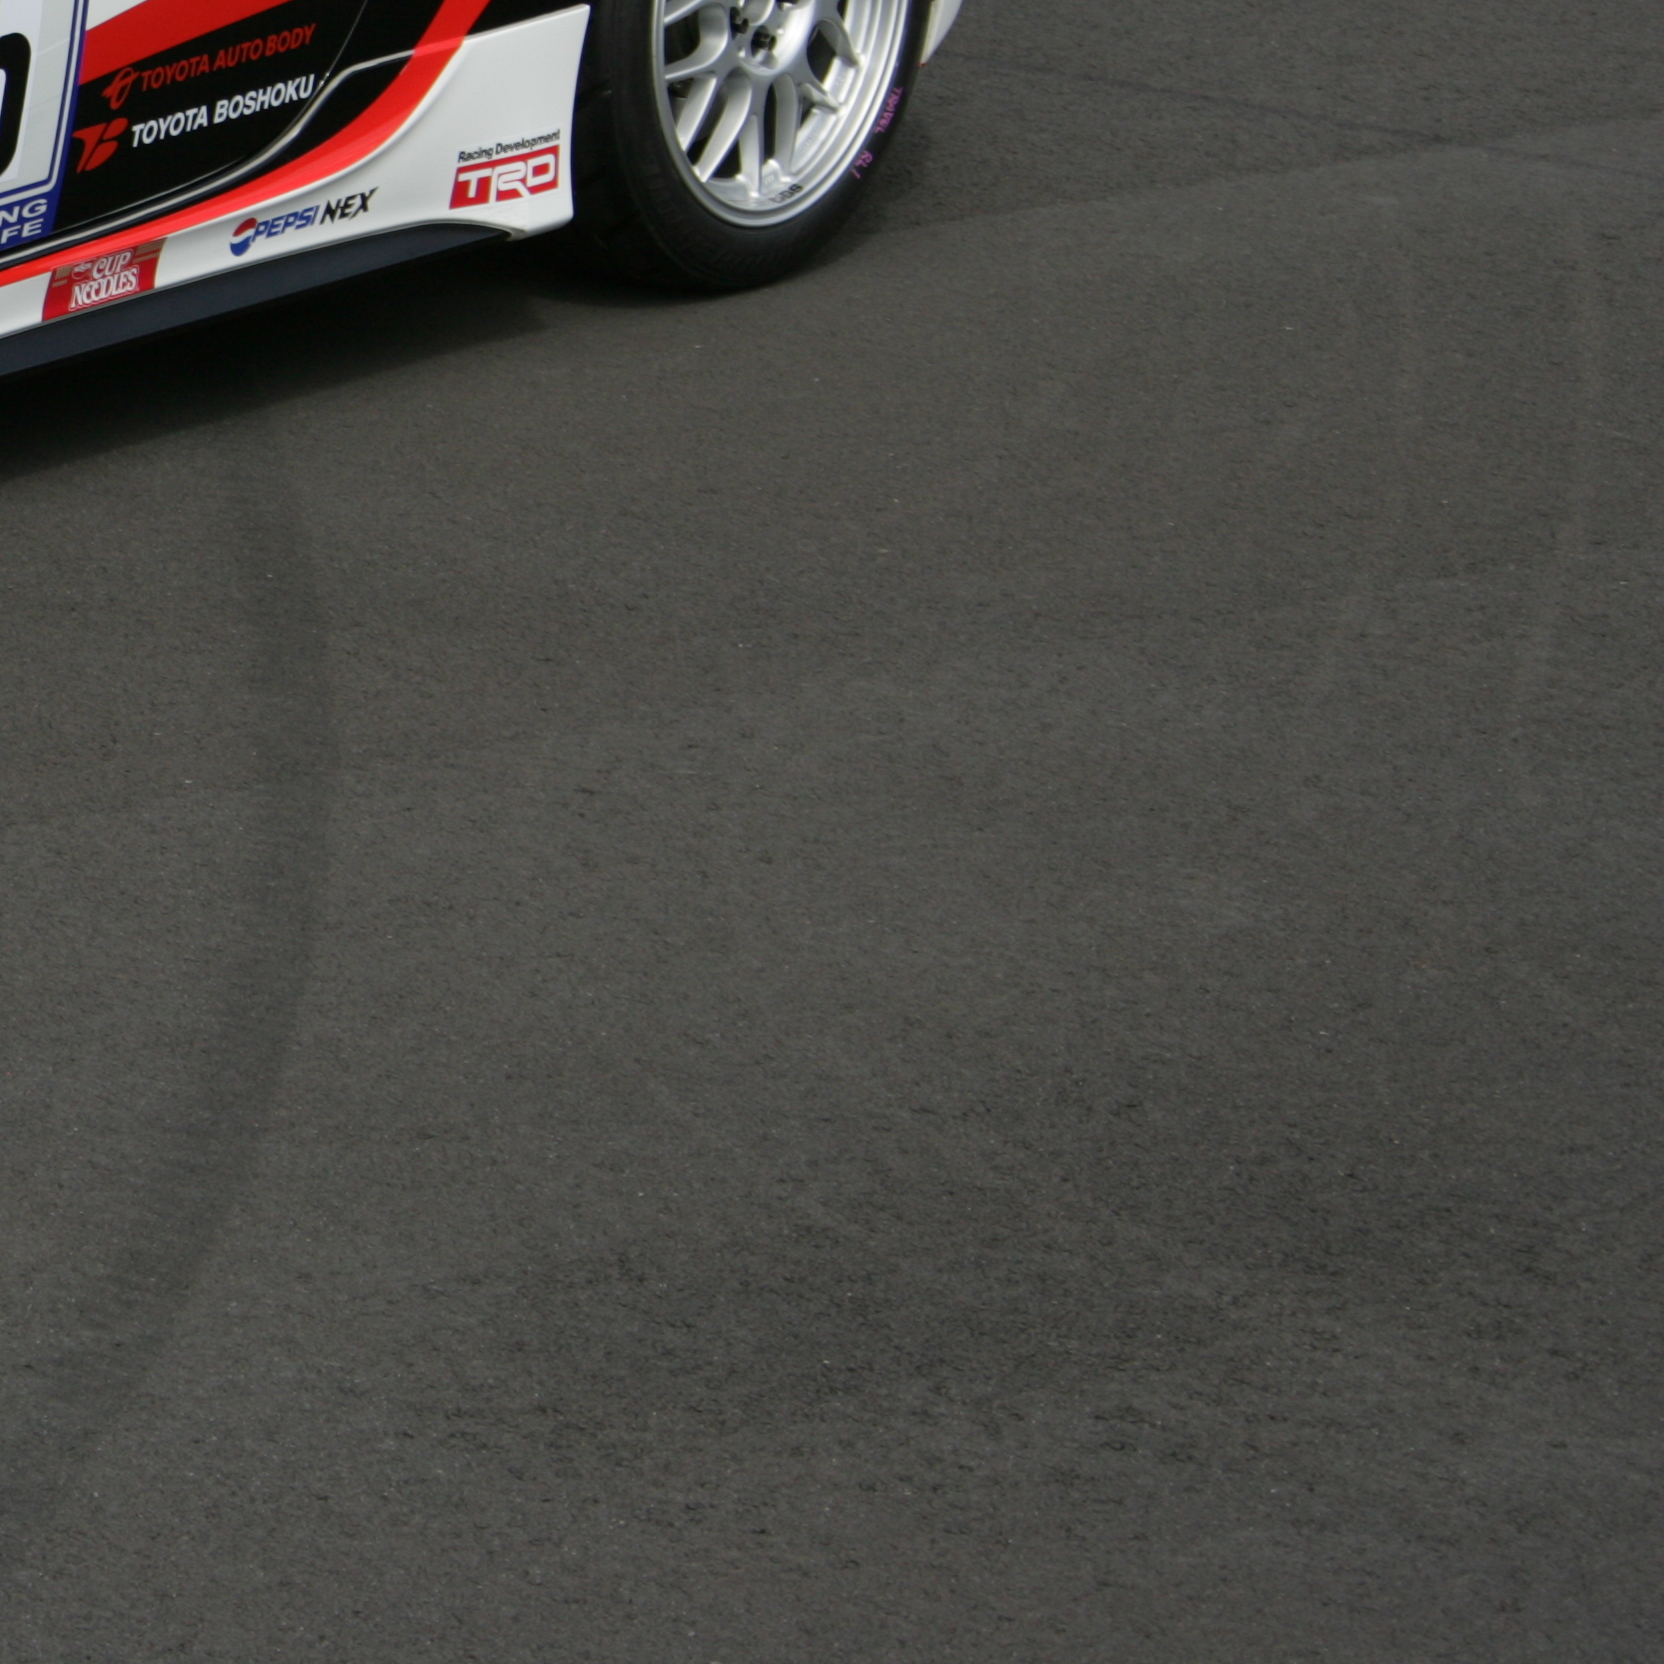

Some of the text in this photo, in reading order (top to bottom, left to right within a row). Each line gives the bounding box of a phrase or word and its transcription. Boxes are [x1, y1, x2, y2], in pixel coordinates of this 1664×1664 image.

[139, 22, 317, 91] TOYOTA AUTO BODY
[131, 73, 316, 149] TOYOTA BOSHOKU
[457, 128, 561, 164] Racing Development
[457, 153, 557, 204] TRD
[250, 186, 379, 243] PEPSI NEX
[69, 267, 138, 309] NOODLES
[92, 251, 133, 279] CUP
